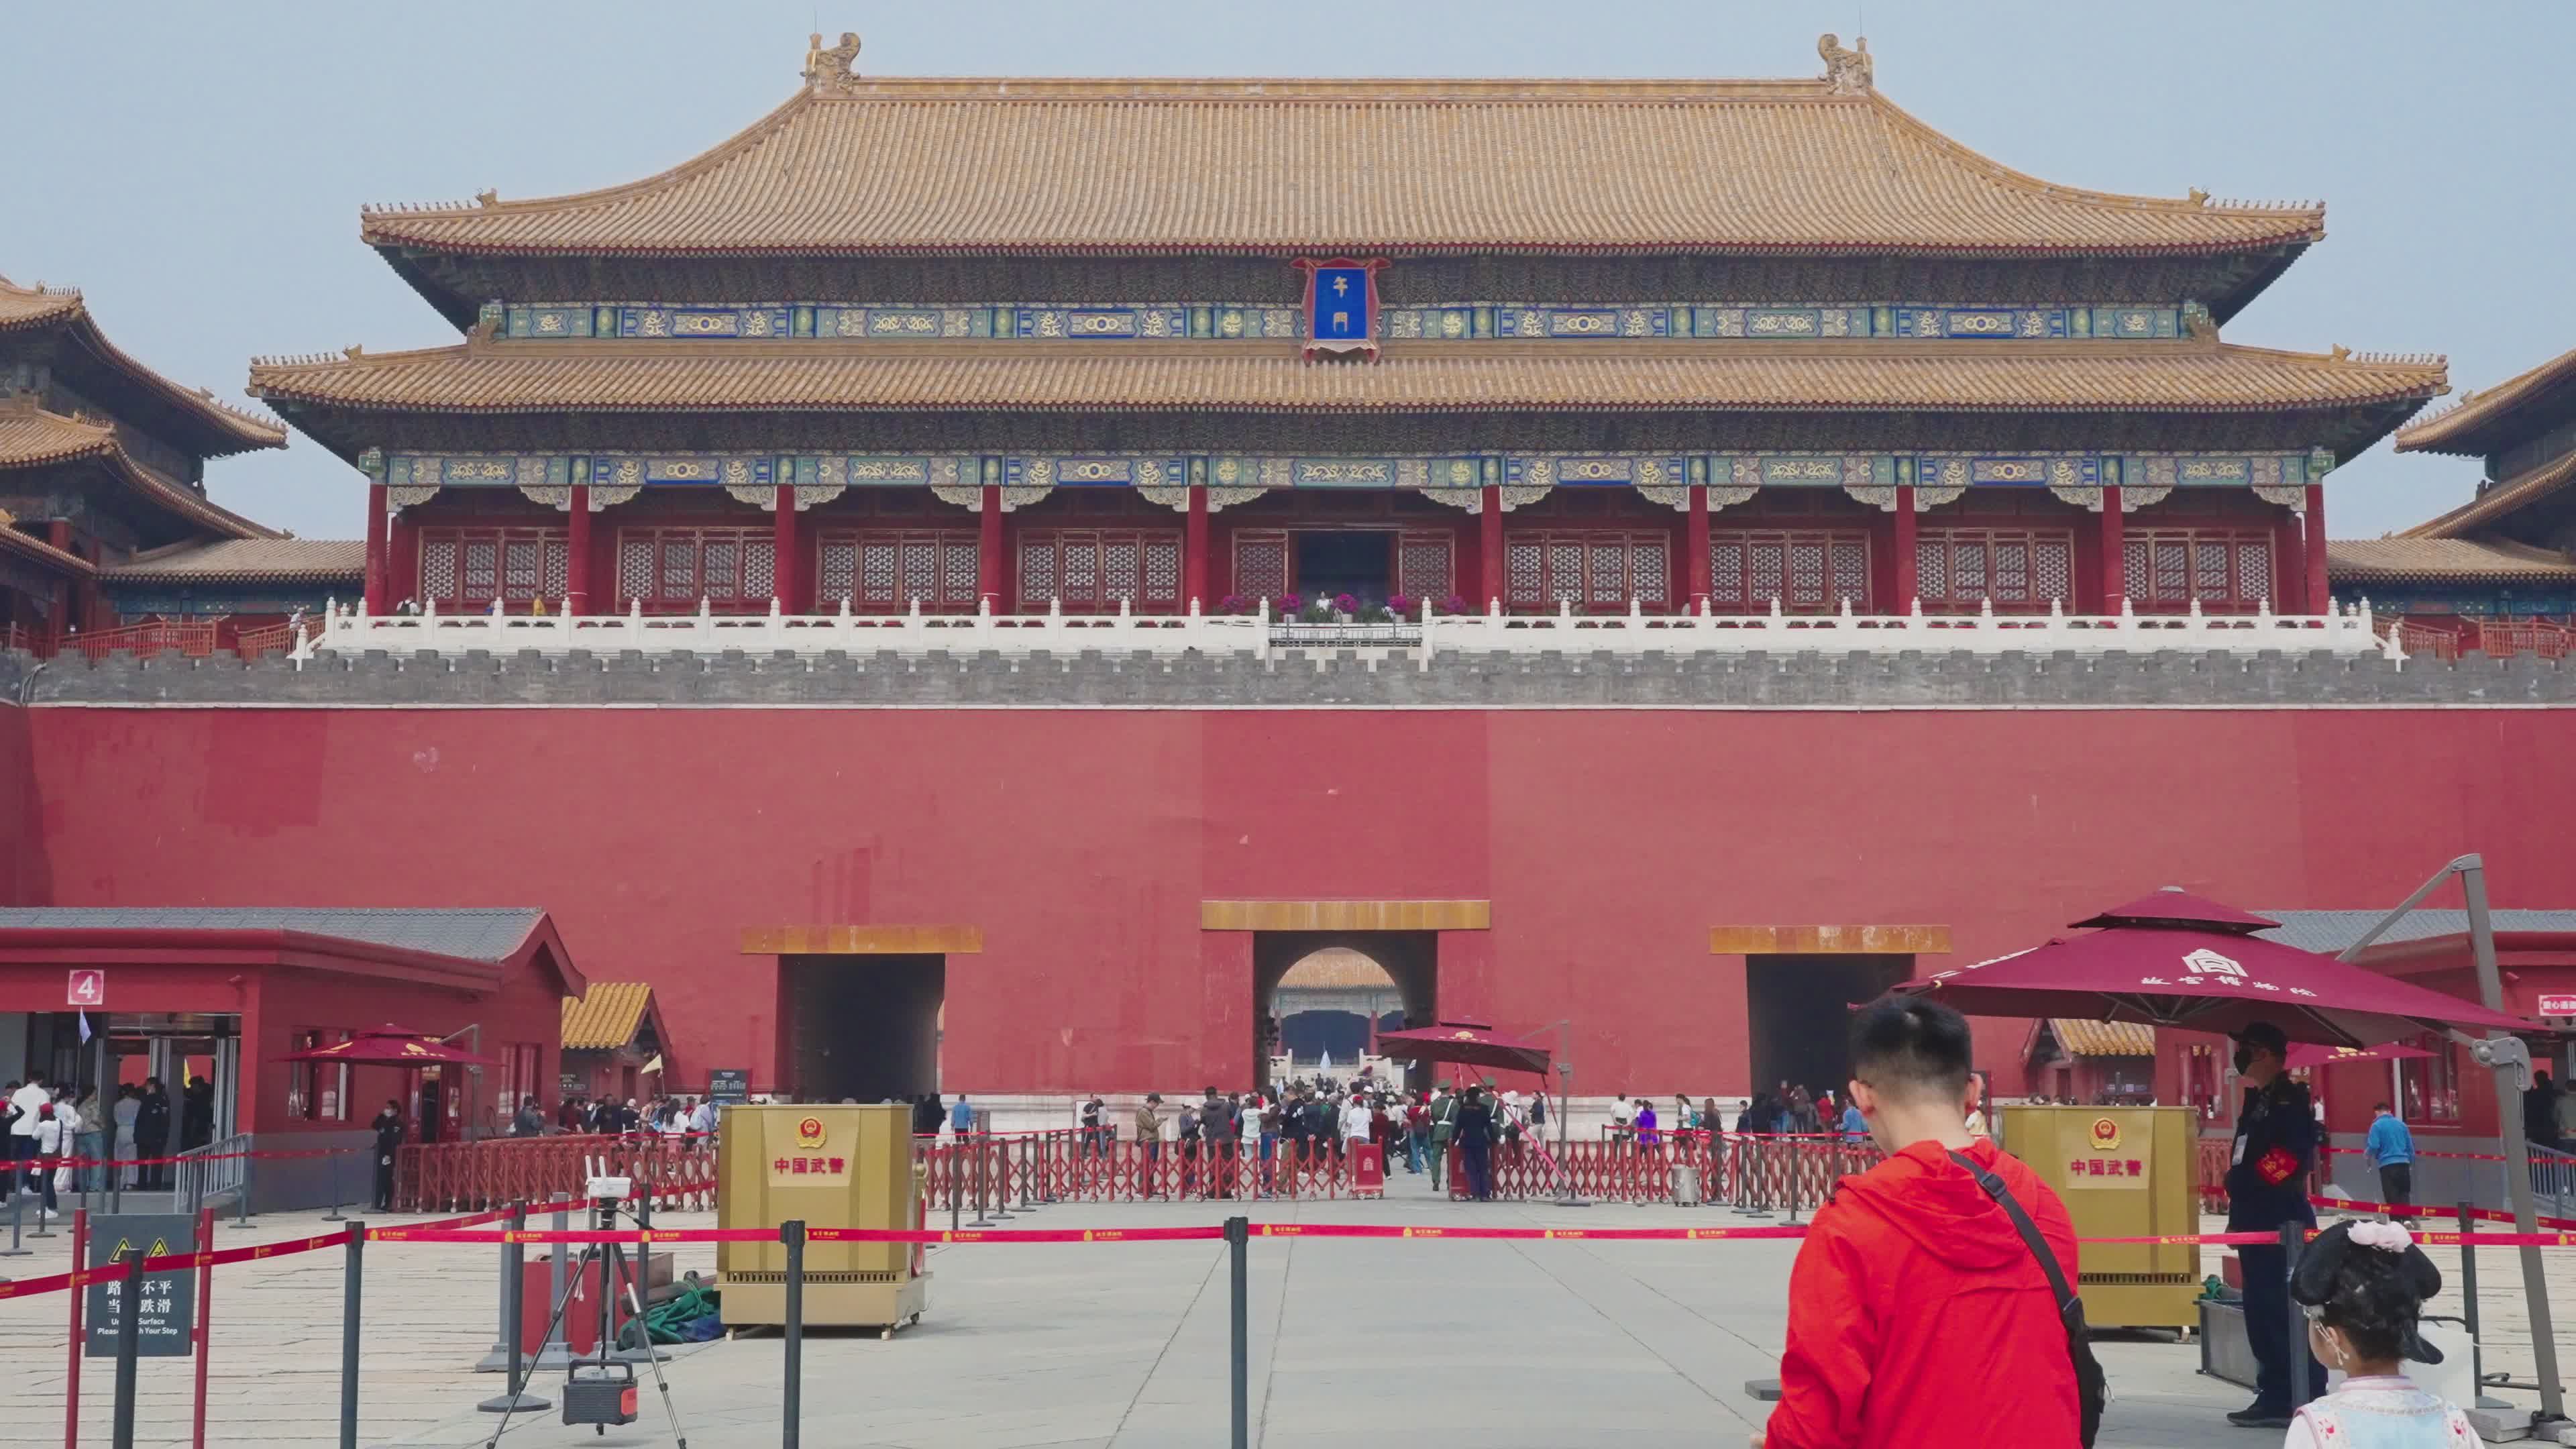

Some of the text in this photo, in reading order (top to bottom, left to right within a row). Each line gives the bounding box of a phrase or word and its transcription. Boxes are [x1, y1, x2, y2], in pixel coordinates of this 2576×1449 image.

[76, 975, 95, 999] 4
[773, 1157, 845, 1175] 中国武警
[2071, 1159, 2142, 1177] 中国武警
[107, 1280, 172, 1295] 路不平
[107, 1298, 172, 1313] 当跌滑
[162, 1327, 178, 1336] Step
